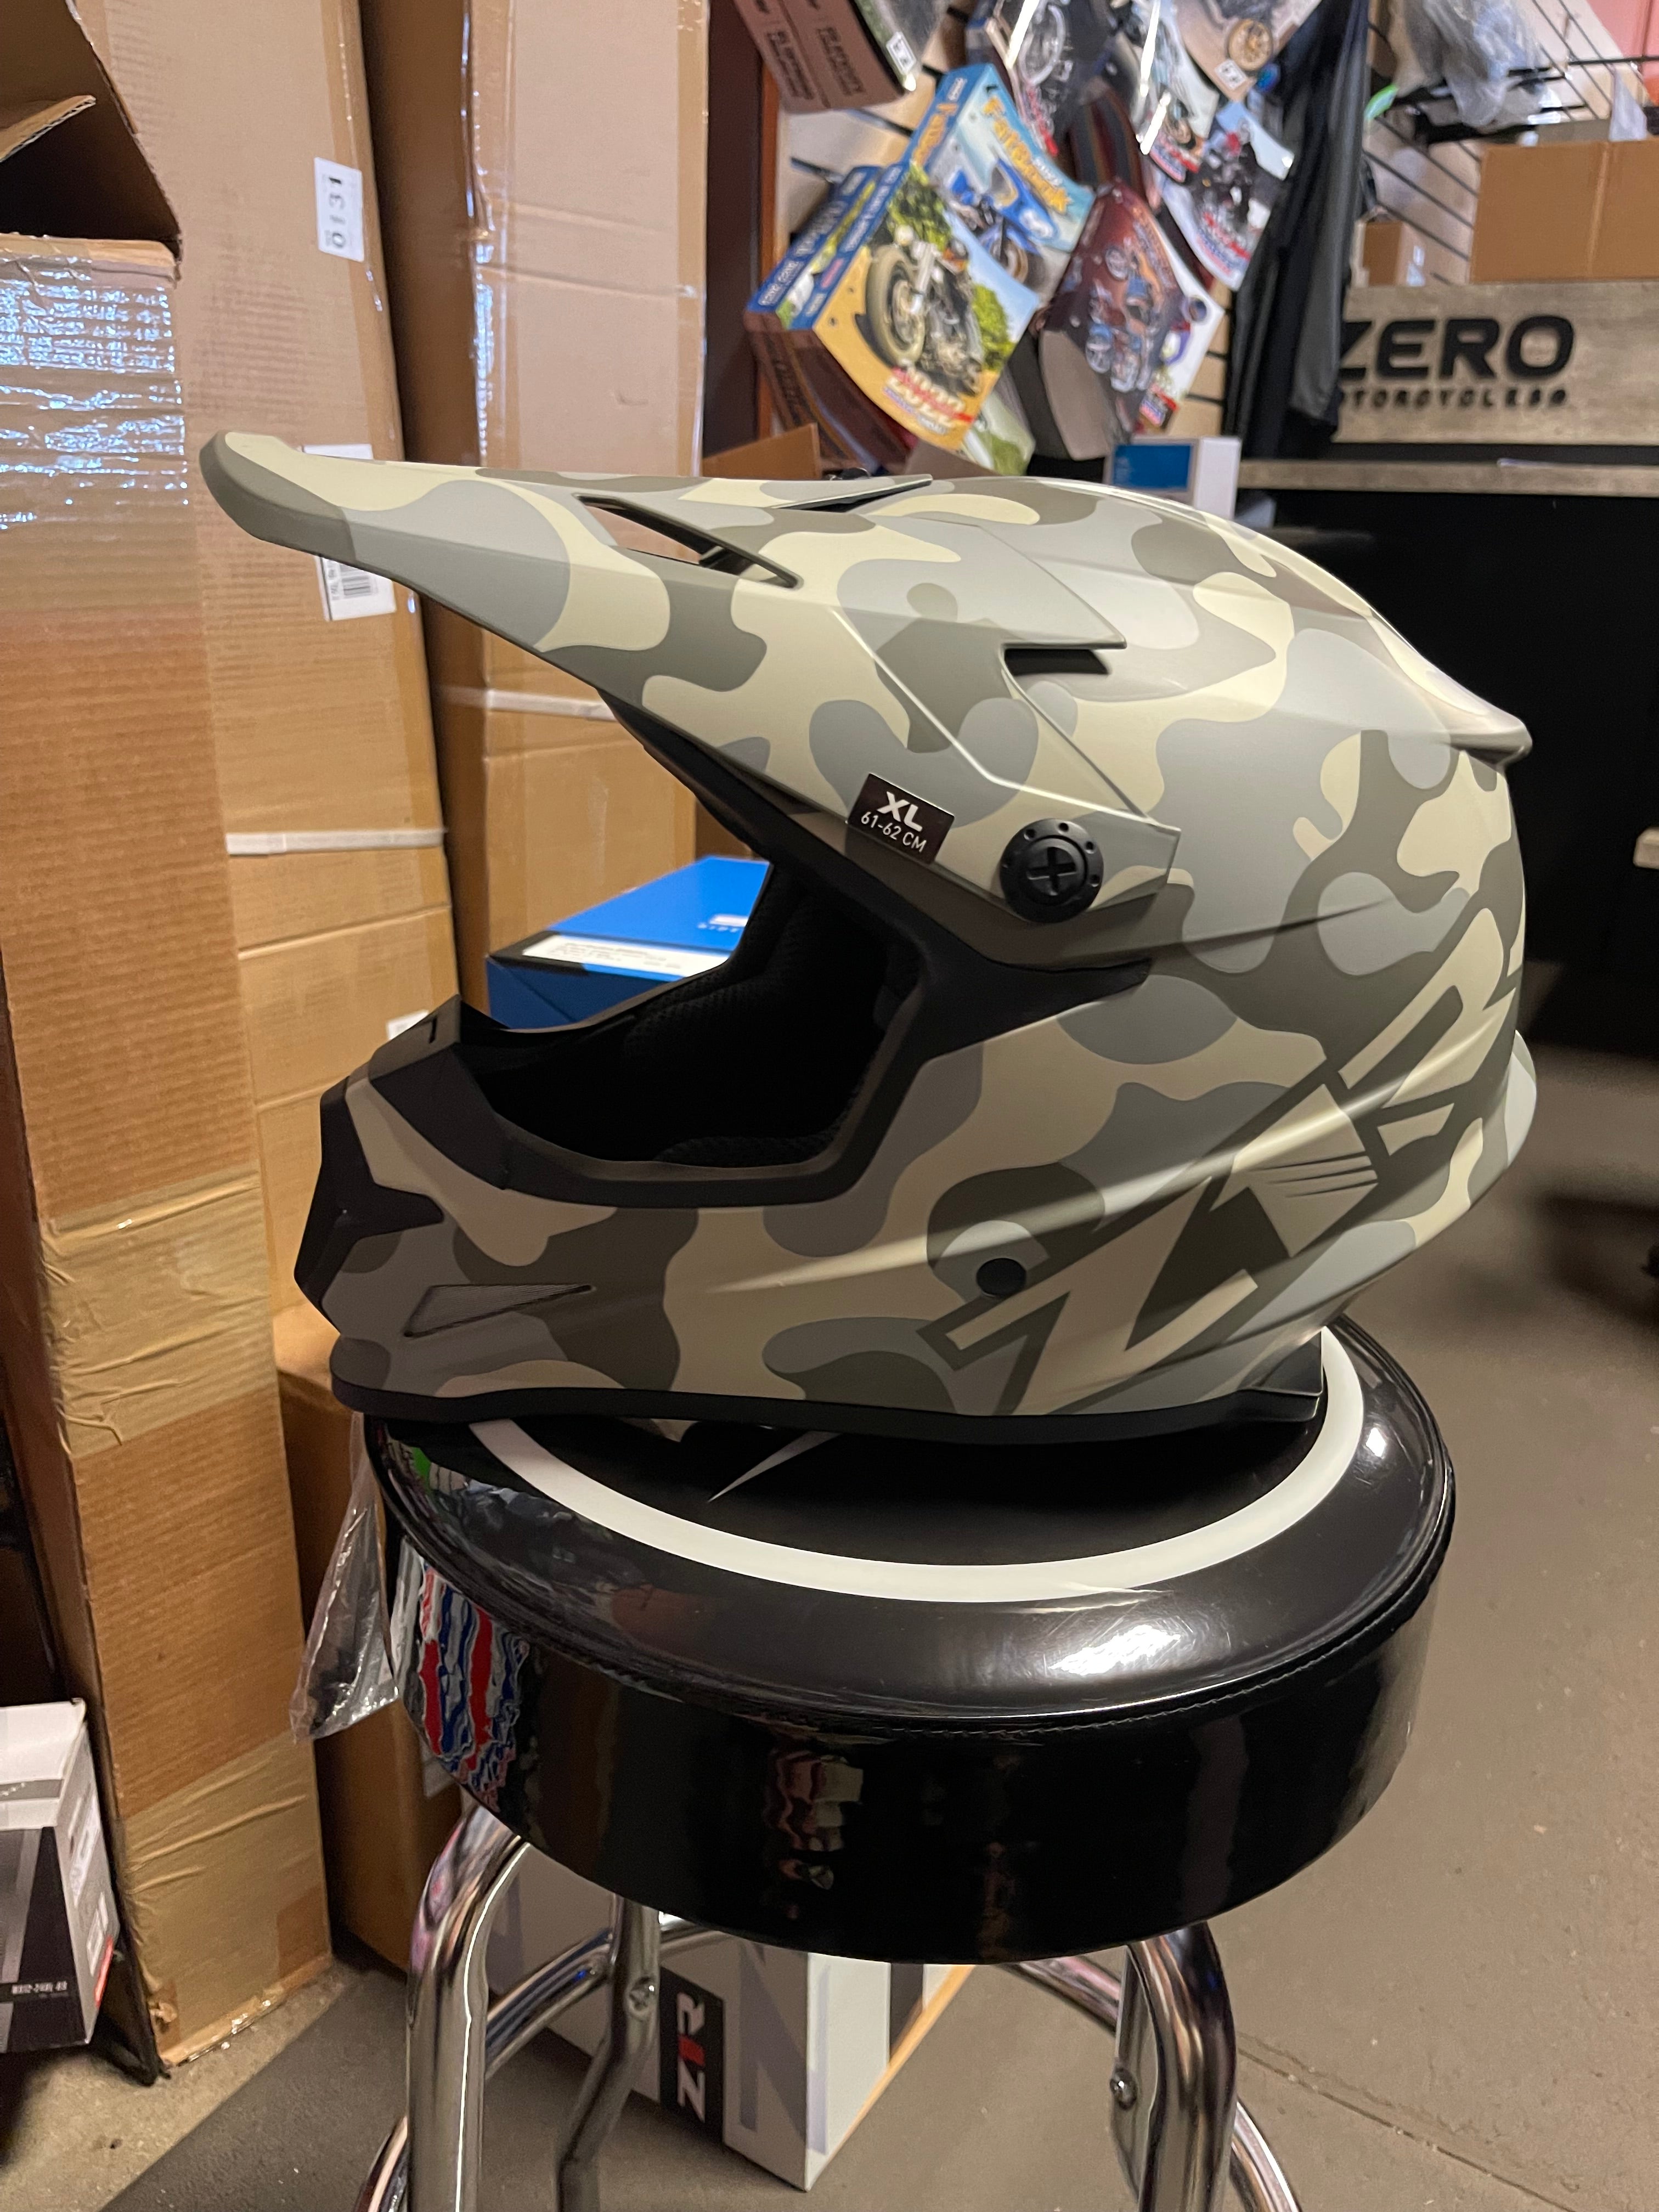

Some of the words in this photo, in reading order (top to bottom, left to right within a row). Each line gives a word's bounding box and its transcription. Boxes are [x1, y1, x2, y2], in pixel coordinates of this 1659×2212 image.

[1339, 315, 1575, 379] ZERO
[860, 811, 902, 841] 61-62
[902, 832, 927, 853] CM
[877, 791, 923, 832] XL
